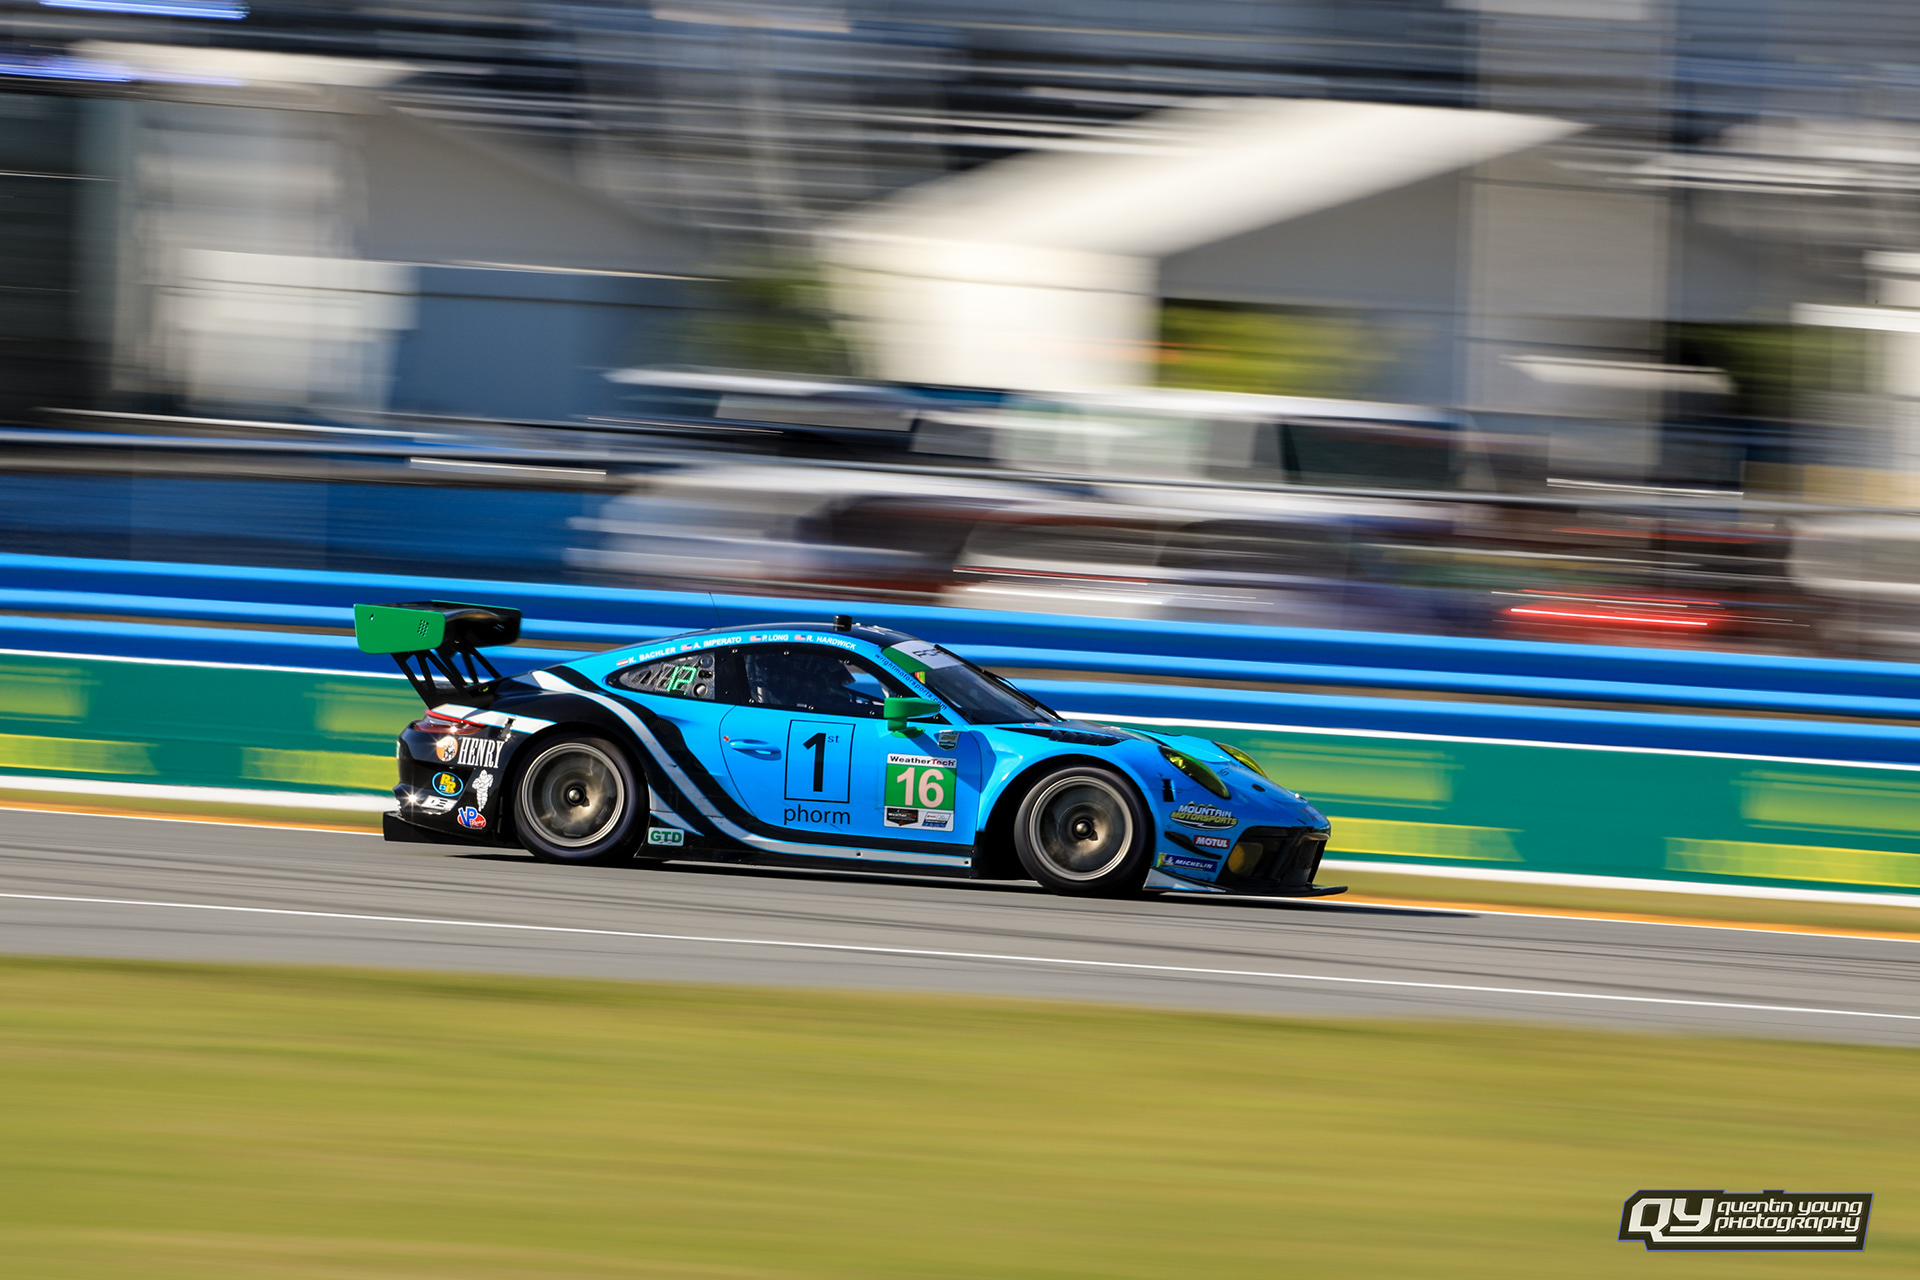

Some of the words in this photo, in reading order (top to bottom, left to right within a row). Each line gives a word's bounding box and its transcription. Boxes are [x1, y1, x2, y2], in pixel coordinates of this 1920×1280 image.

[703, 636, 742, 647] IMPERATO
[816, 635, 857, 650] HARDWICK
[628, 656, 637, 664] K.
[639, 646, 676, 661] BACHLER
[457, 736, 505, 769] HENRY
[889, 755, 955, 767] WeatherTech
[896, 766, 944, 808] 16
[458, 807, 478, 828] VP
[784, 804, 850, 825] phorm
[1170, 811, 1238, 825] MOTORSPORTS
[1178, 804, 1232, 818] MOUNTAIN
[650, 830, 683, 844] GTD
[1195, 836, 1229, 848] MOTUL
[1174, 858, 1214, 870] MICHELIN
